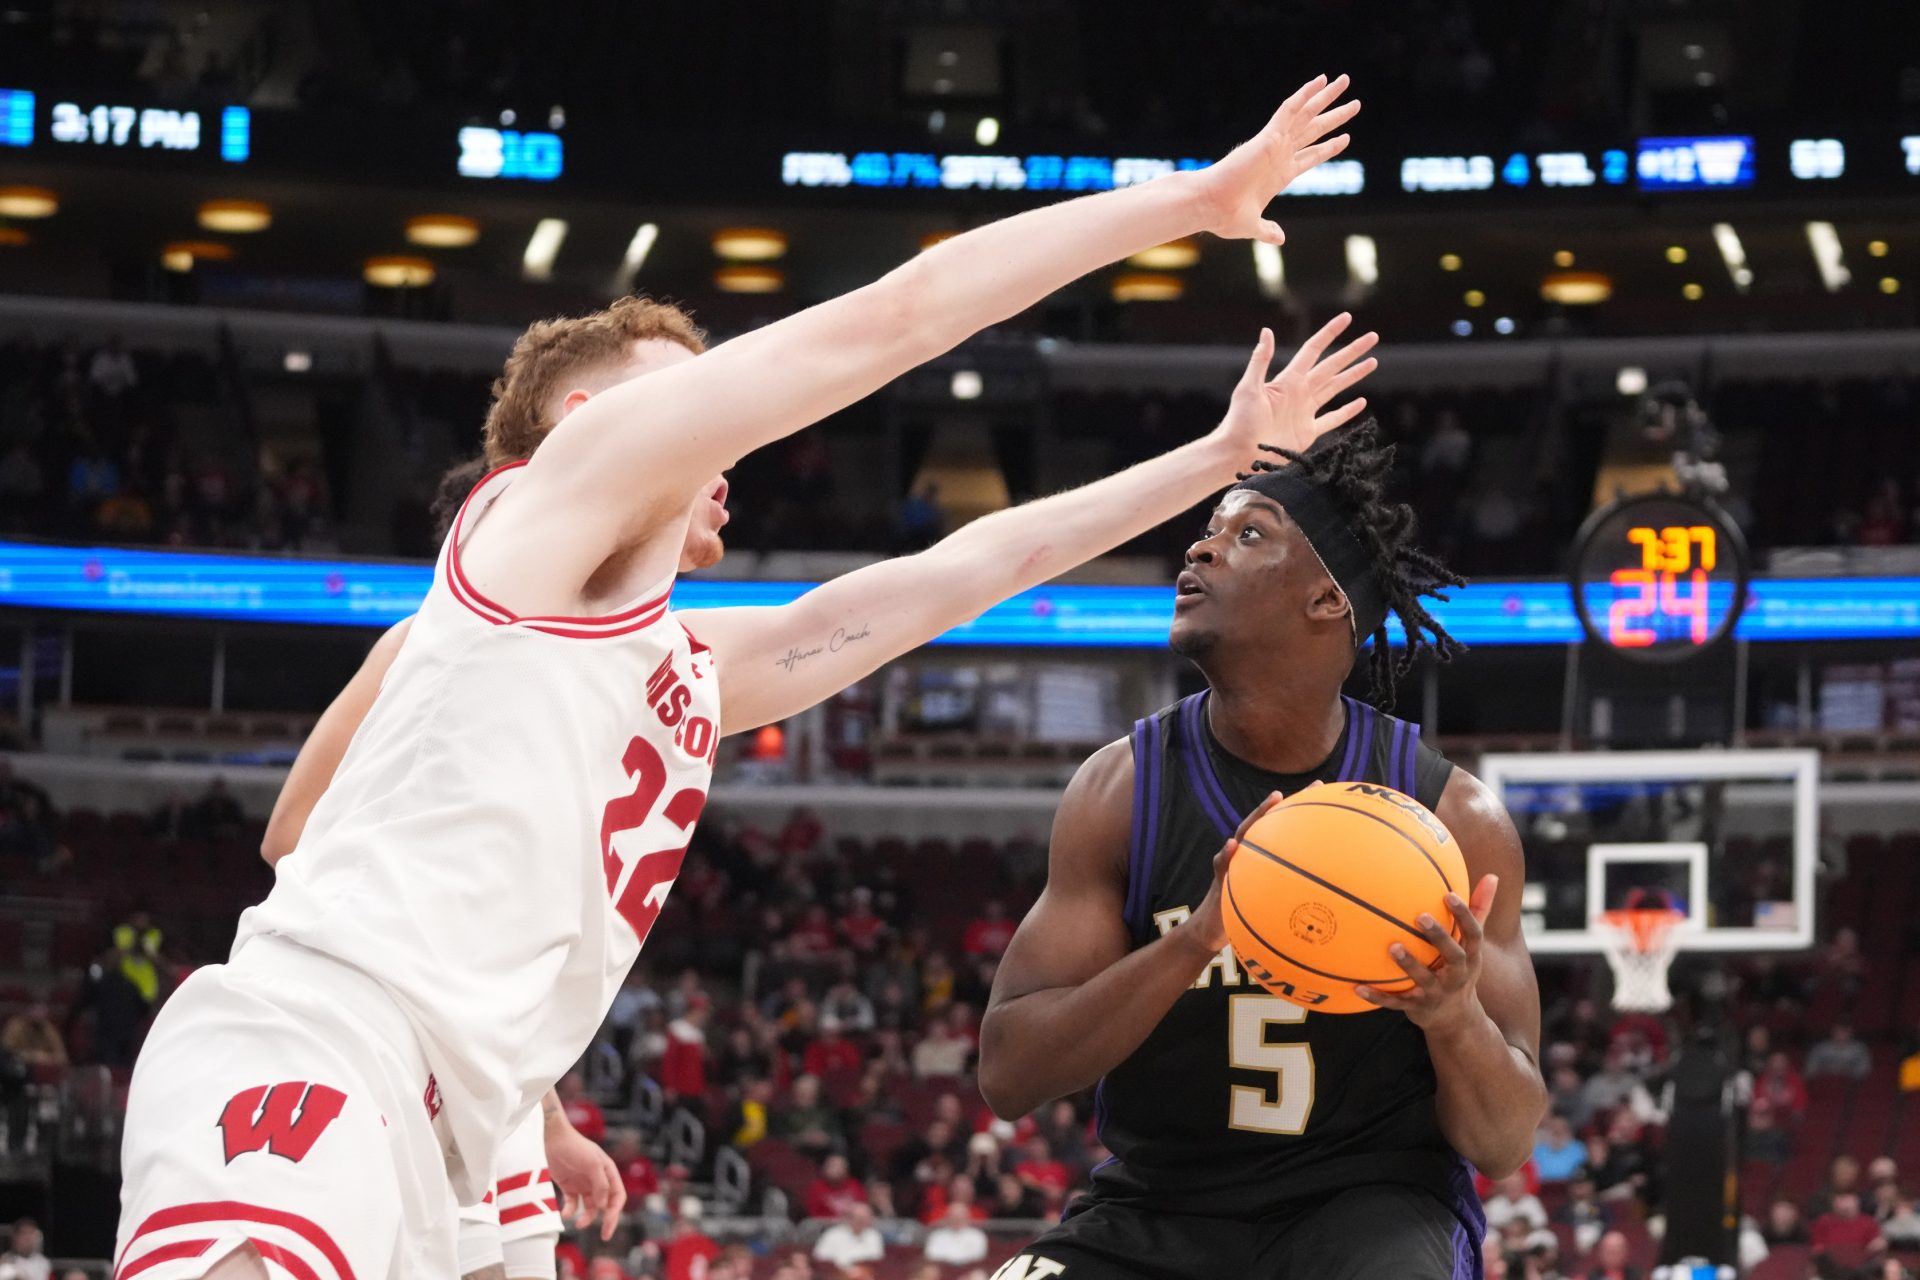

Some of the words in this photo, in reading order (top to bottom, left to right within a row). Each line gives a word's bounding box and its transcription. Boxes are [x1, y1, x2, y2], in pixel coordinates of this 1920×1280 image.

[52, 103, 136, 146] 3:17
[140, 108, 200, 150] PM
[1503, 152, 1530, 187] 4
[1602, 149, 1628, 184] 2
[1627, 526, 1716, 573] 7:37
[1609, 568, 1708, 647] 24
[600, 735, 706, 946] 22
[1228, 993, 1316, 1135] 5
[215, 1080, 349, 1167] W
